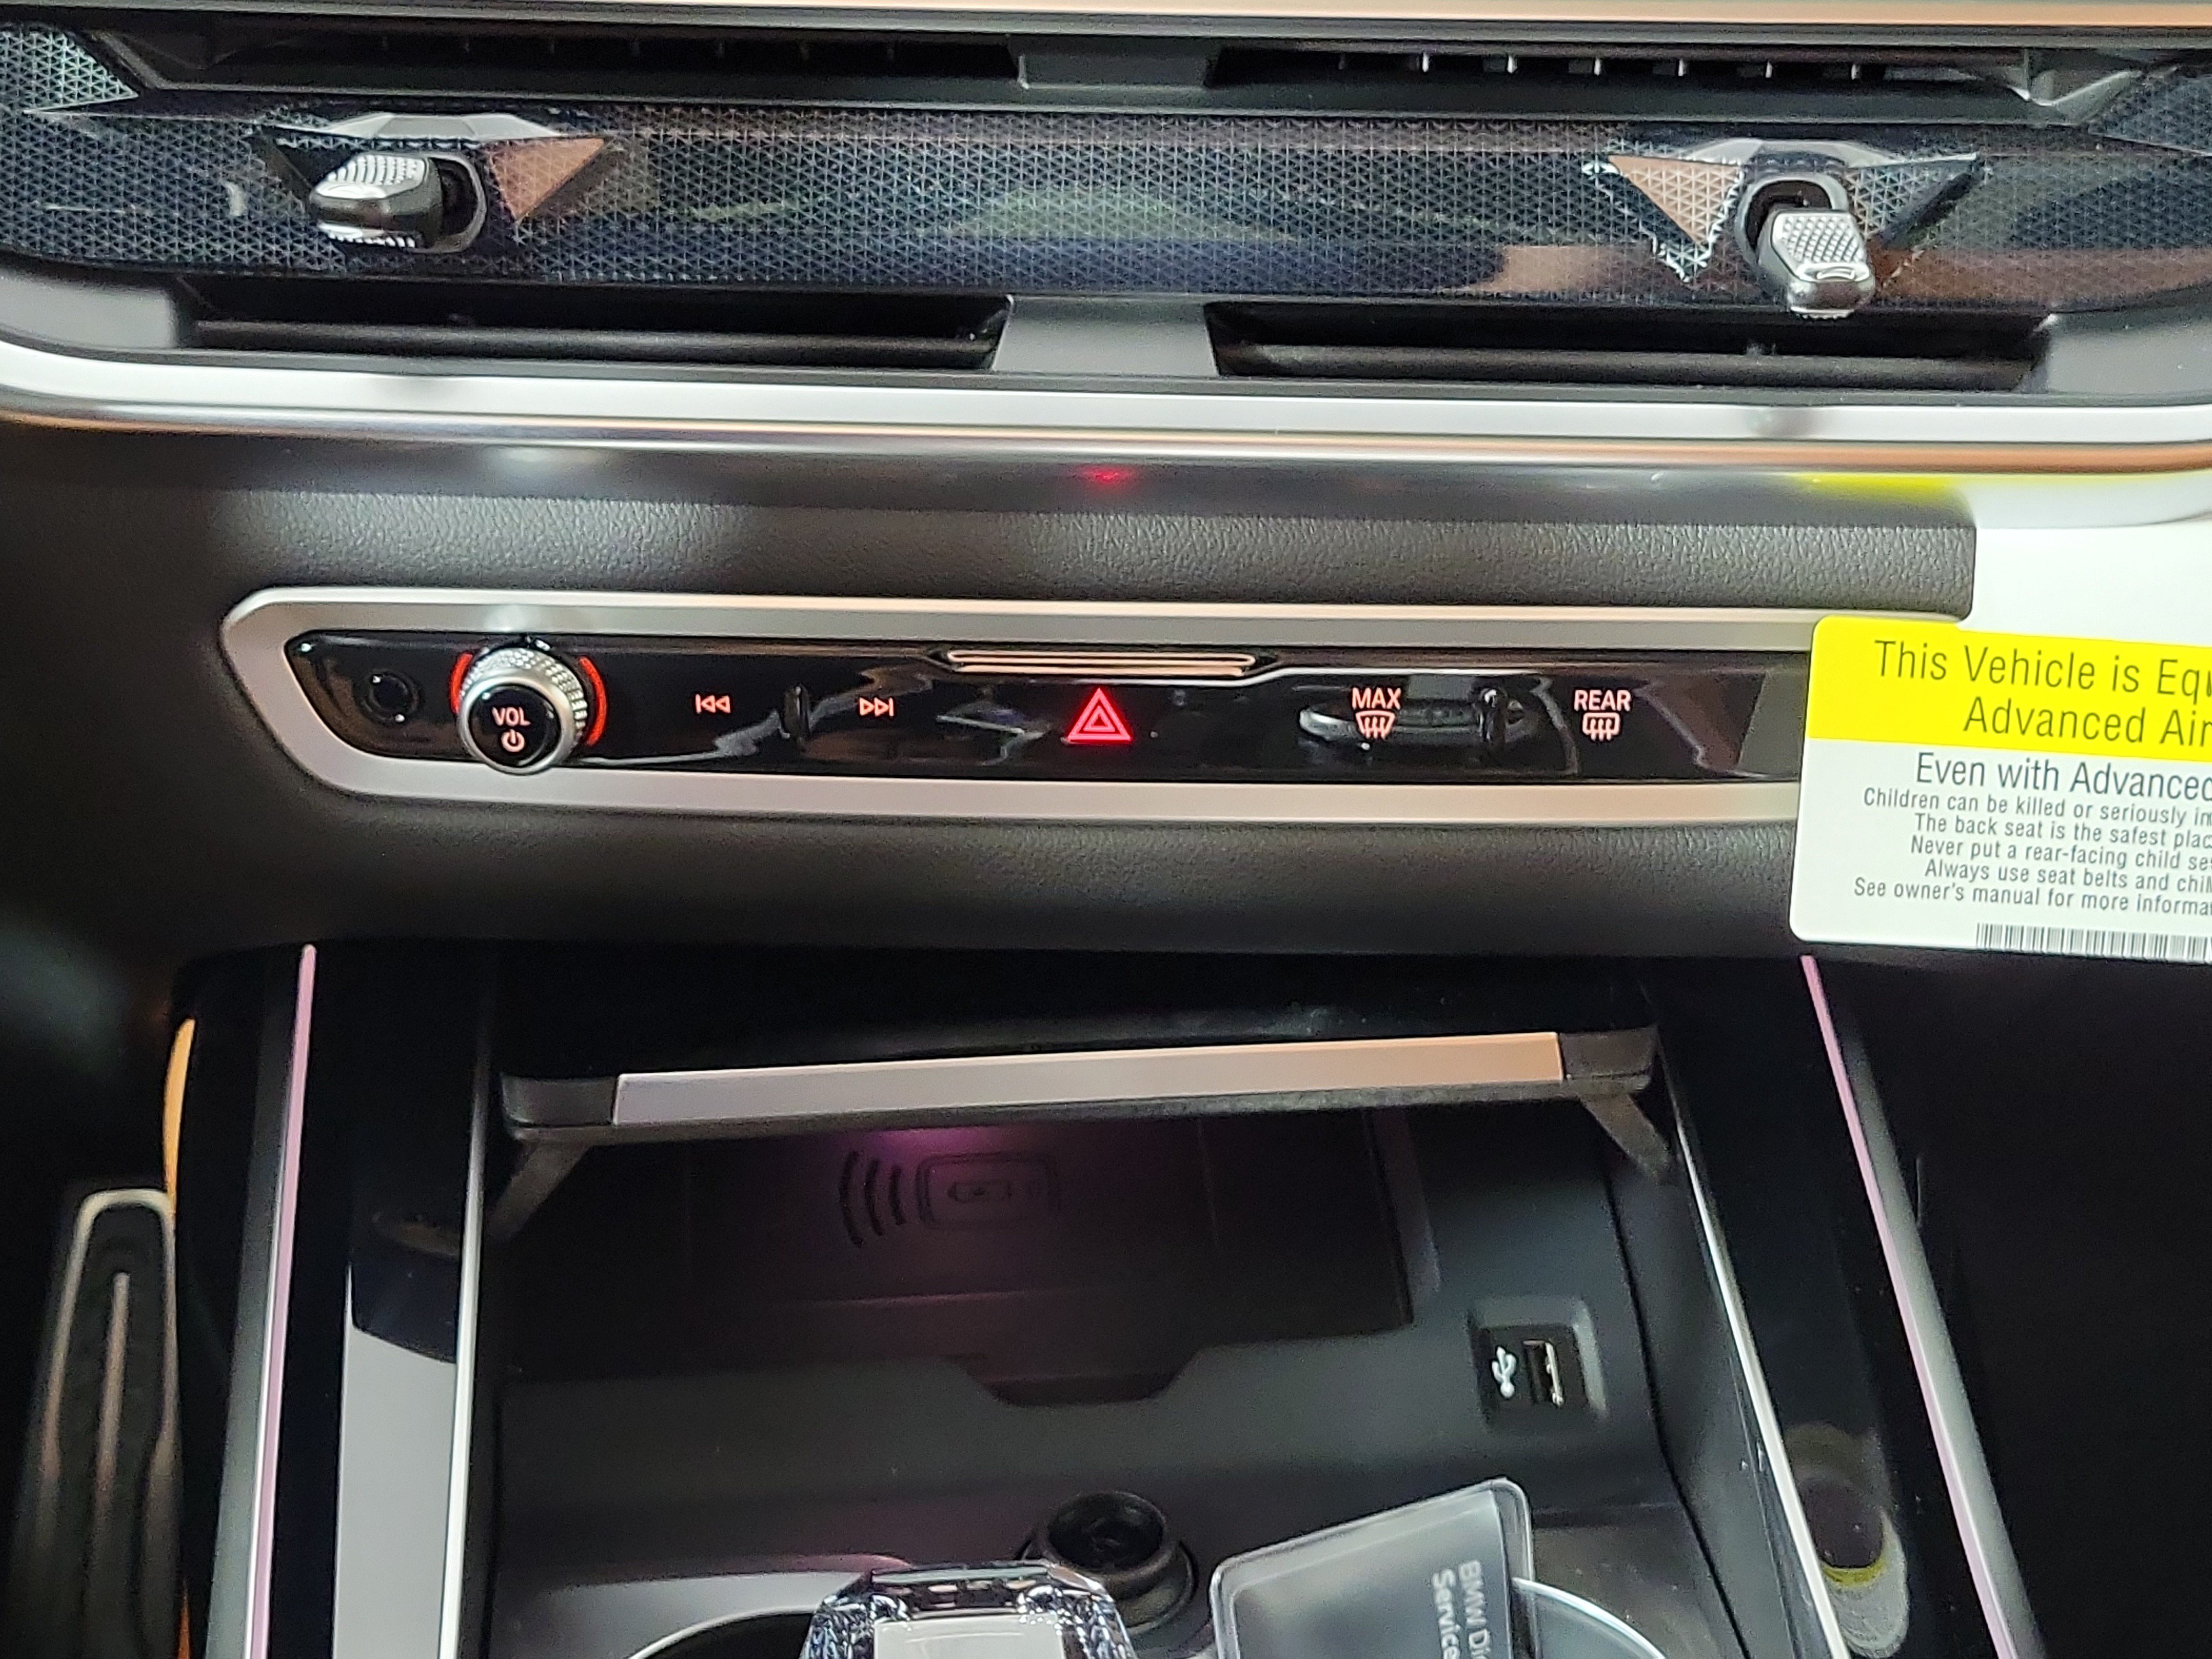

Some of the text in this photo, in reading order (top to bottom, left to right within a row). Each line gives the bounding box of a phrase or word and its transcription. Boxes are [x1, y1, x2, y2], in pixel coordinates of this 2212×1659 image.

[1875, 640, 2212, 705] This Vehicle is Eq
[492, 706, 531, 727] VOL
[1352, 687, 1402, 709] MAX
[1574, 689, 1631, 711] REAR
[1962, 696, 2146, 743] Advanced
[1916, 752, 1985, 786] Even
[1997, 757, 2059, 791] with
[1864, 787, 1939, 809] Children
[1948, 794, 1979, 811] can
[1987, 794, 2008, 814] be
[2016, 795, 2066, 817] killed
[2073, 803, 2094, 818] or
[2100, 803, 2187, 828] seriously
[1915, 812, 1947, 832] The
[1955, 815, 1997, 835] back
[2004, 821, 2043, 838] seat
[2050, 821, 2065, 839] is
[2074, 823, 2101, 842] the
[2109, 826, 2166, 846] safest
[1911, 834, 2212, 871] Never put a rear-facing child se
[1925, 858, 1989, 883] Always
[1997, 866, 2029, 882] use
[2037, 867, 2075, 885] seat
[2083, 867, 2128, 888] belts
[2135, 873, 2169, 890] and
[1854, 877, 2212, 916] See owner's manual for more informa
[1431, 1568, 1460, 1659] Service
[1458, 1560, 1487, 1628] BMW
